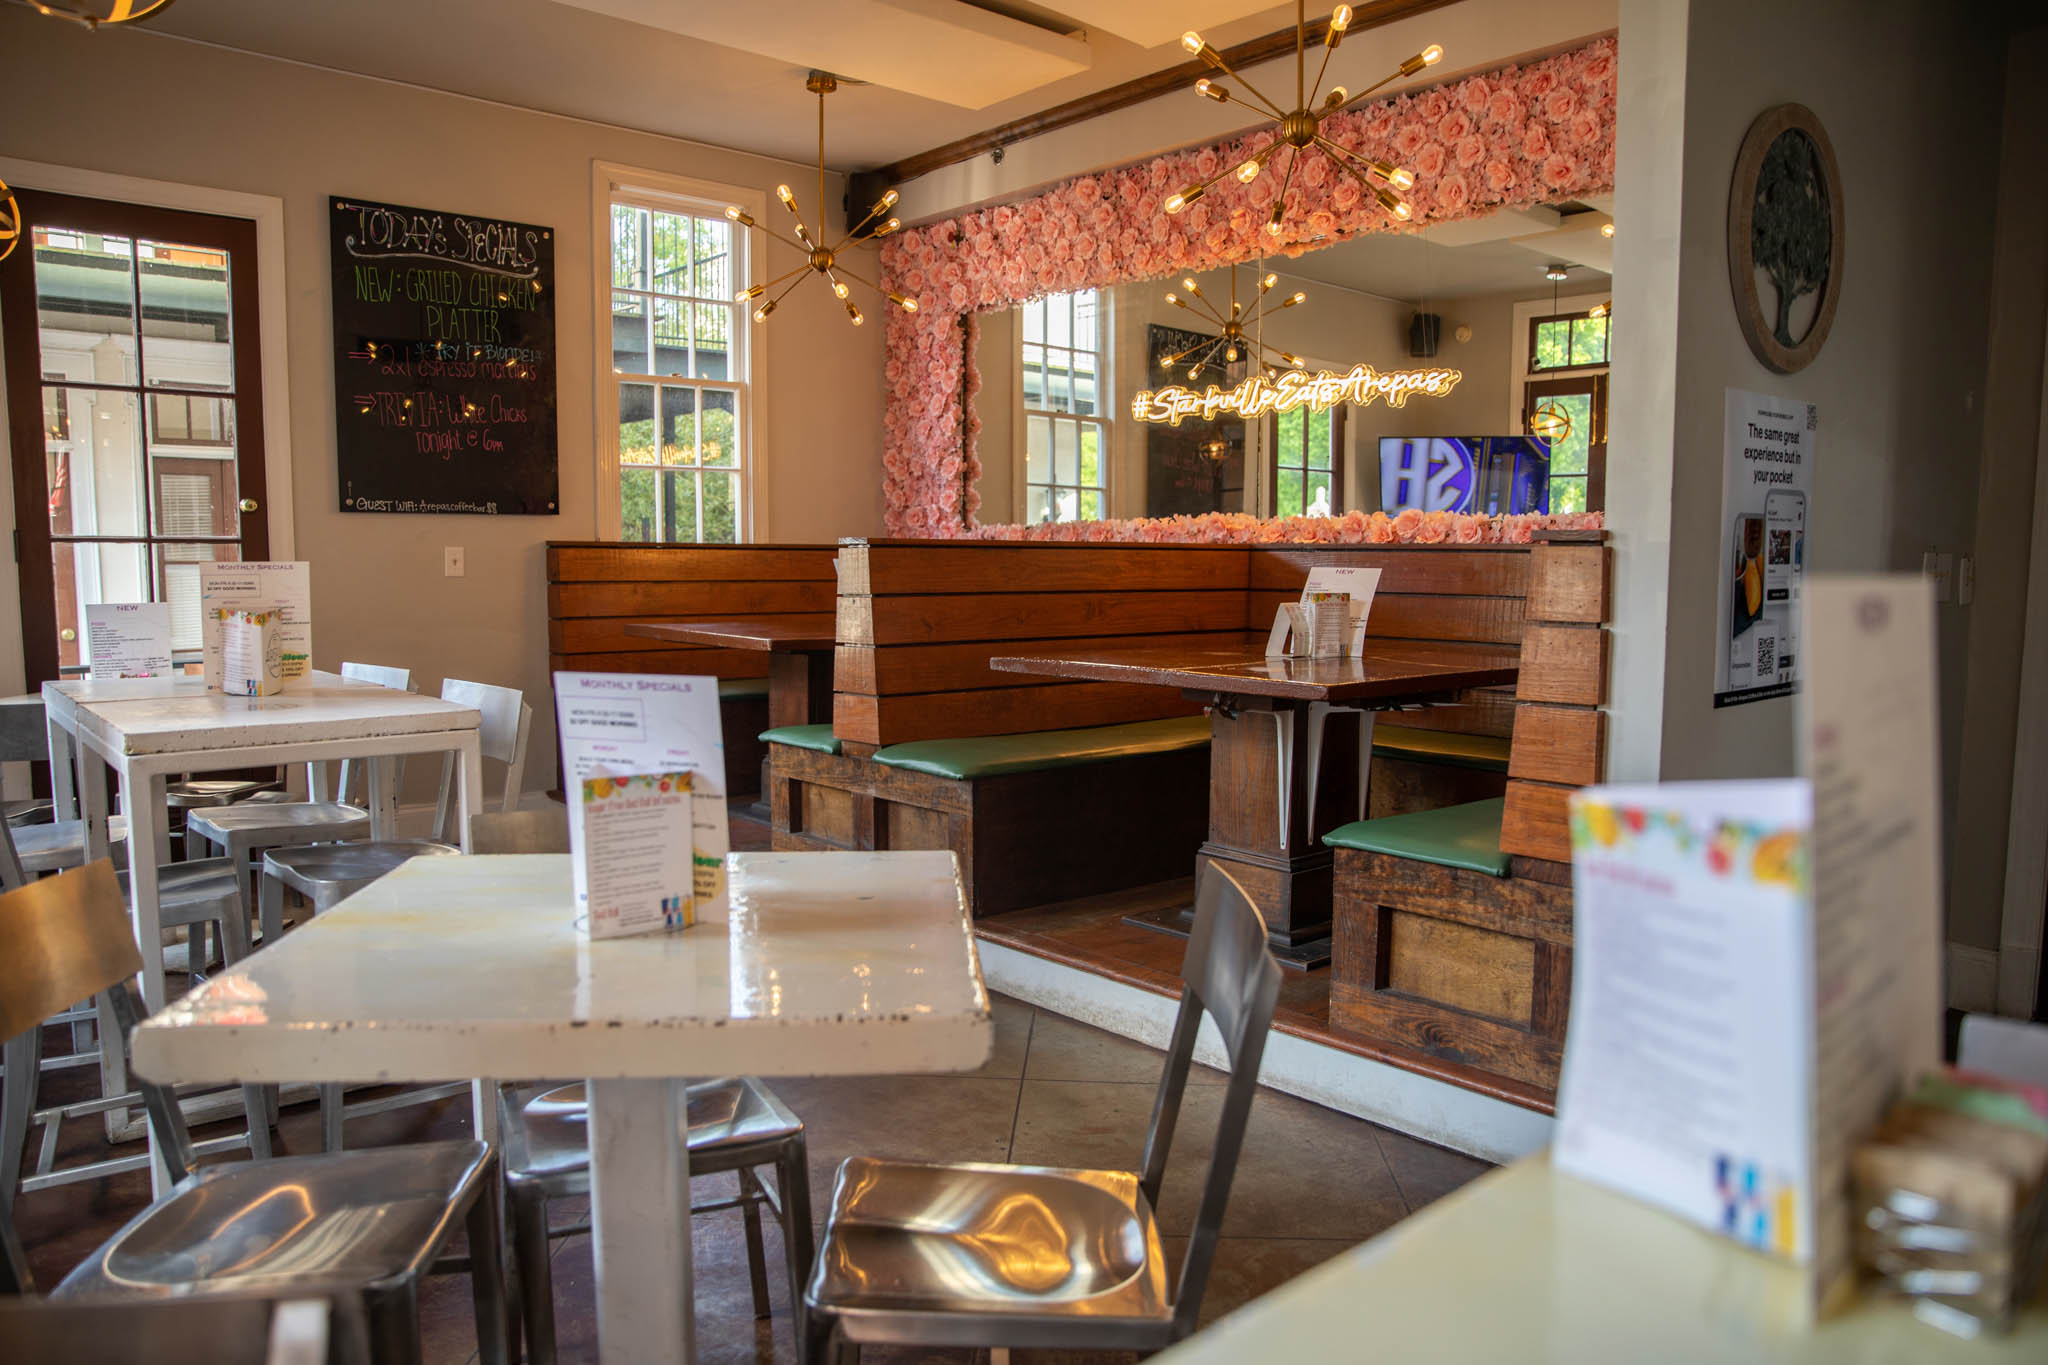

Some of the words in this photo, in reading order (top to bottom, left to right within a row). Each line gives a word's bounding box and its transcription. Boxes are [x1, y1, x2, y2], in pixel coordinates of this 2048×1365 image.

[452, 217, 538, 268] SPECIALS
[406, 267, 462, 305] GRILLED
[469, 272, 537, 312] CHICKEN
[427, 305, 501, 343] PLATTER
[1748, 422, 1763, 439] The
[1764, 428, 1783, 442] same
[1783, 431, 1800, 446] great
[1744, 446, 1783, 464] experience
[1784, 449, 1795, 465] but
[1795, 450, 1801, 465] in
[1753, 470, 1768, 485] your
[1768, 468, 1793, 486] pocket
[580, 679, 633, 691] MONTHLY
[636, 680, 692, 693] SPECIALS
